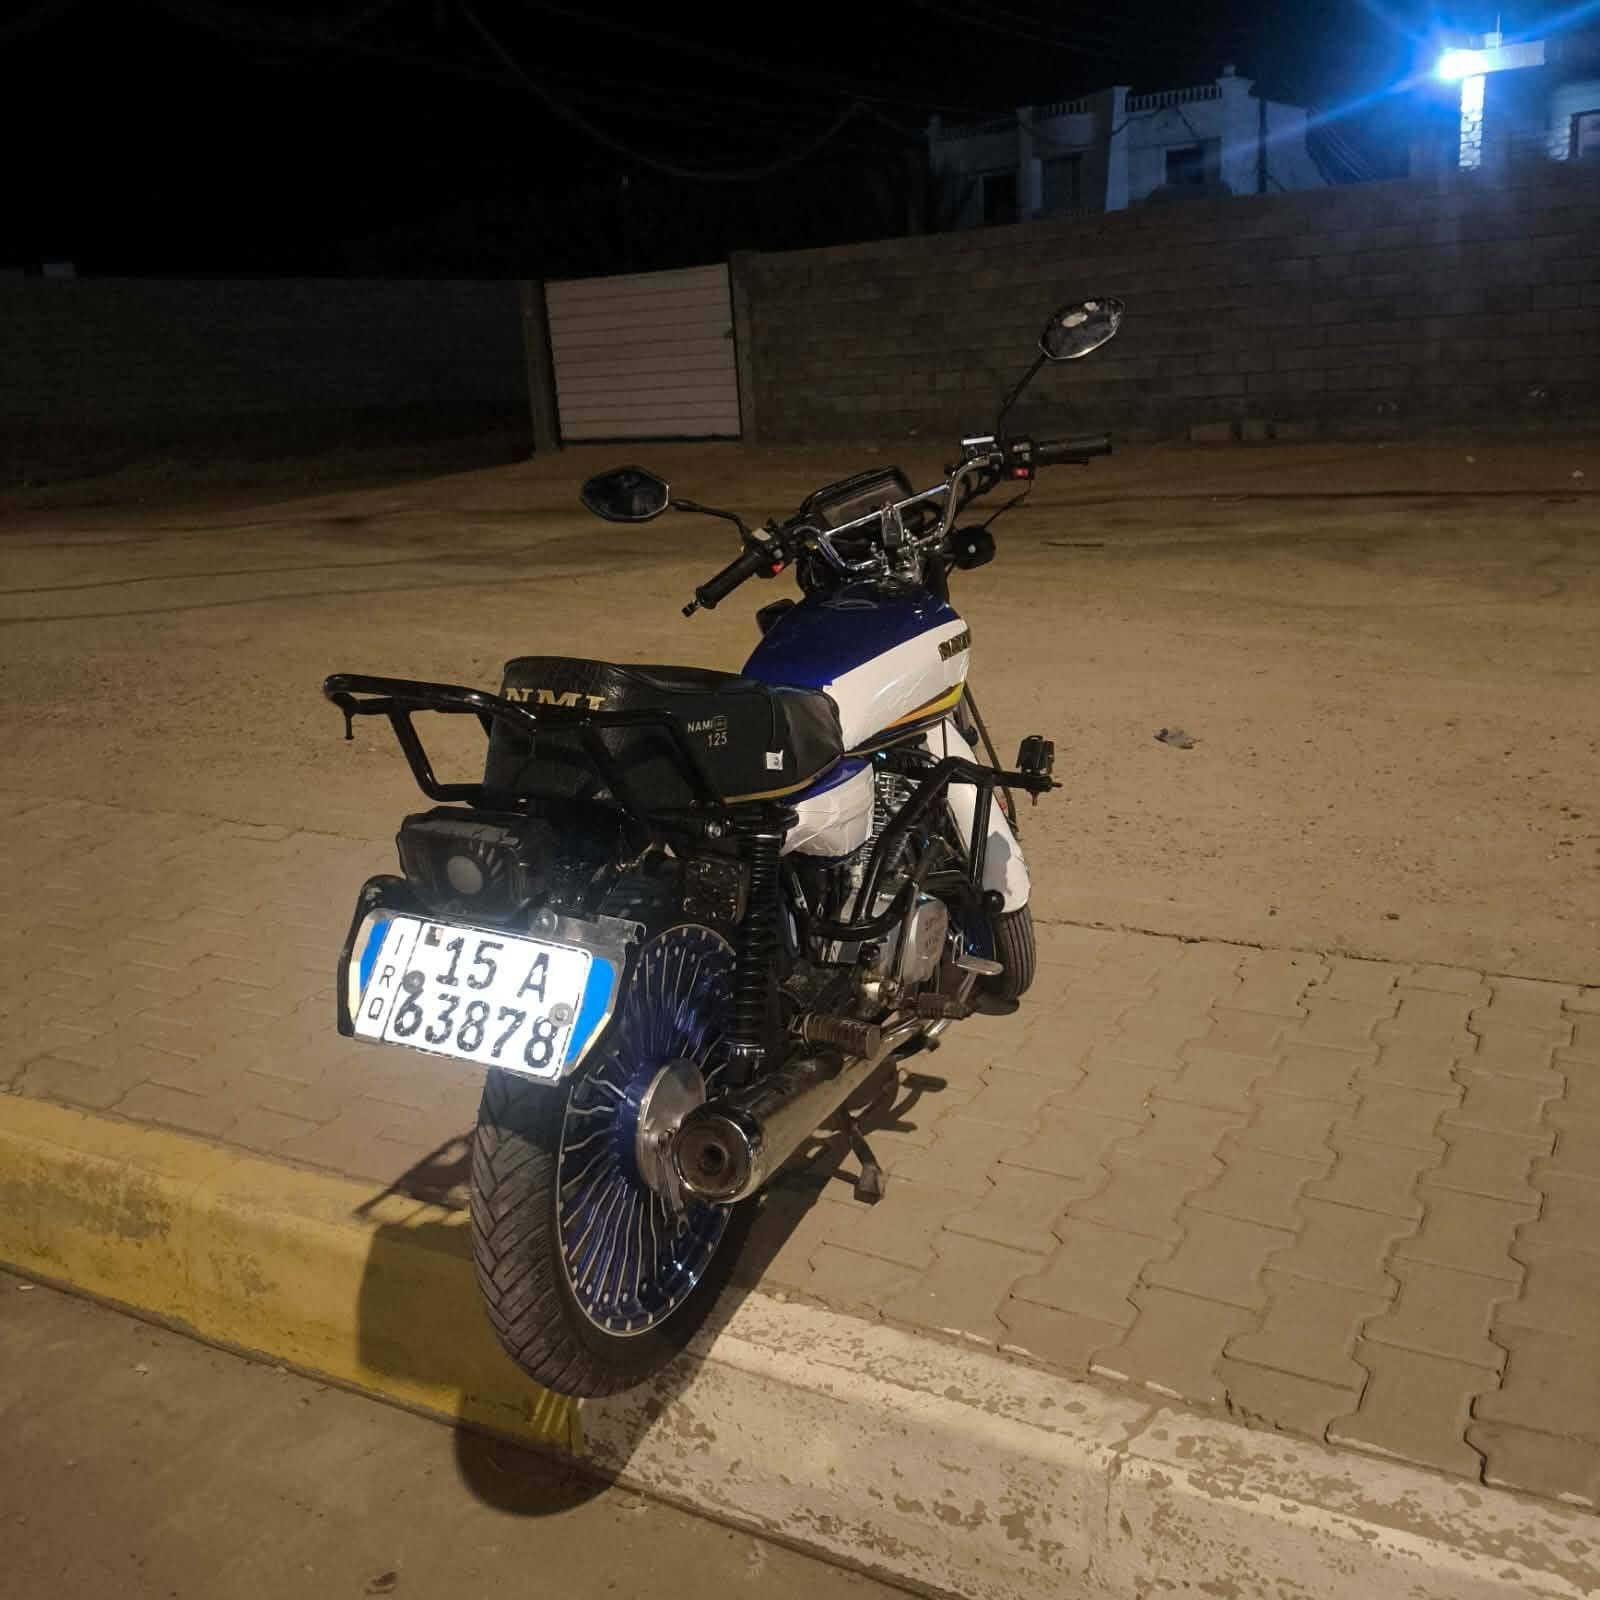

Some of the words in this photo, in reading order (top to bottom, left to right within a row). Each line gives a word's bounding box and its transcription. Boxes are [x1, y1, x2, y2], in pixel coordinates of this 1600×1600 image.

[707, 731, 728, 747] 125
[436, 937, 504, 989] 15
[516, 952, 549, 1003] A
[394, 986, 558, 1068] 63878
